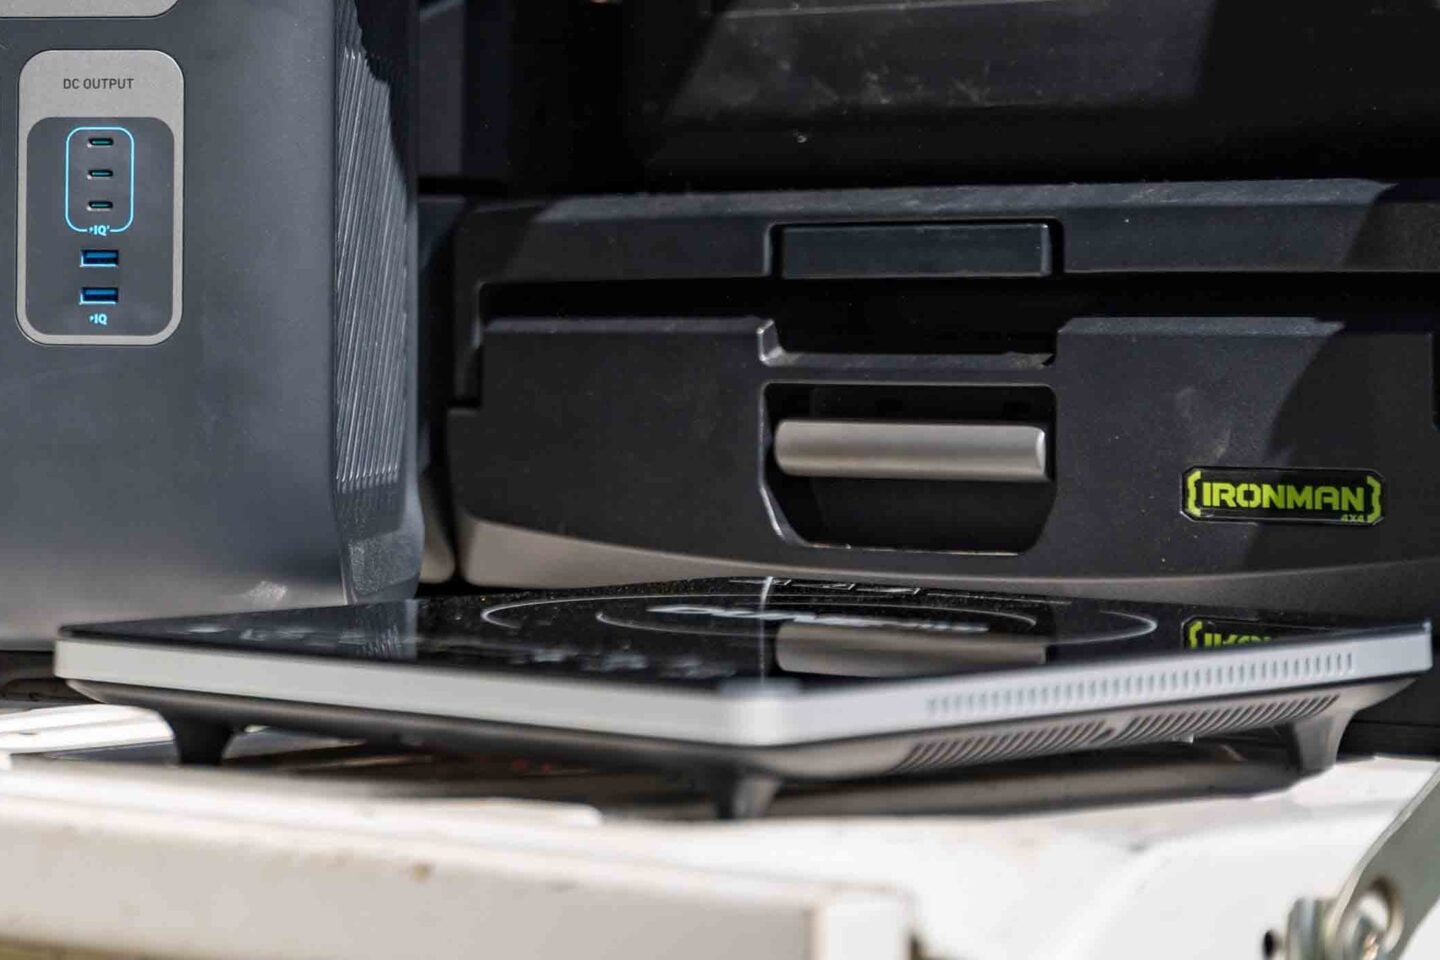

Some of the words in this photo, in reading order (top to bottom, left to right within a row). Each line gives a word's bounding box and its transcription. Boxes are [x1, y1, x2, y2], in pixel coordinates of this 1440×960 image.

[63, 77, 80, 89] DC
[82, 77, 135, 89] OUTPUT
[1202, 481, 1365, 512] IRONMAN
